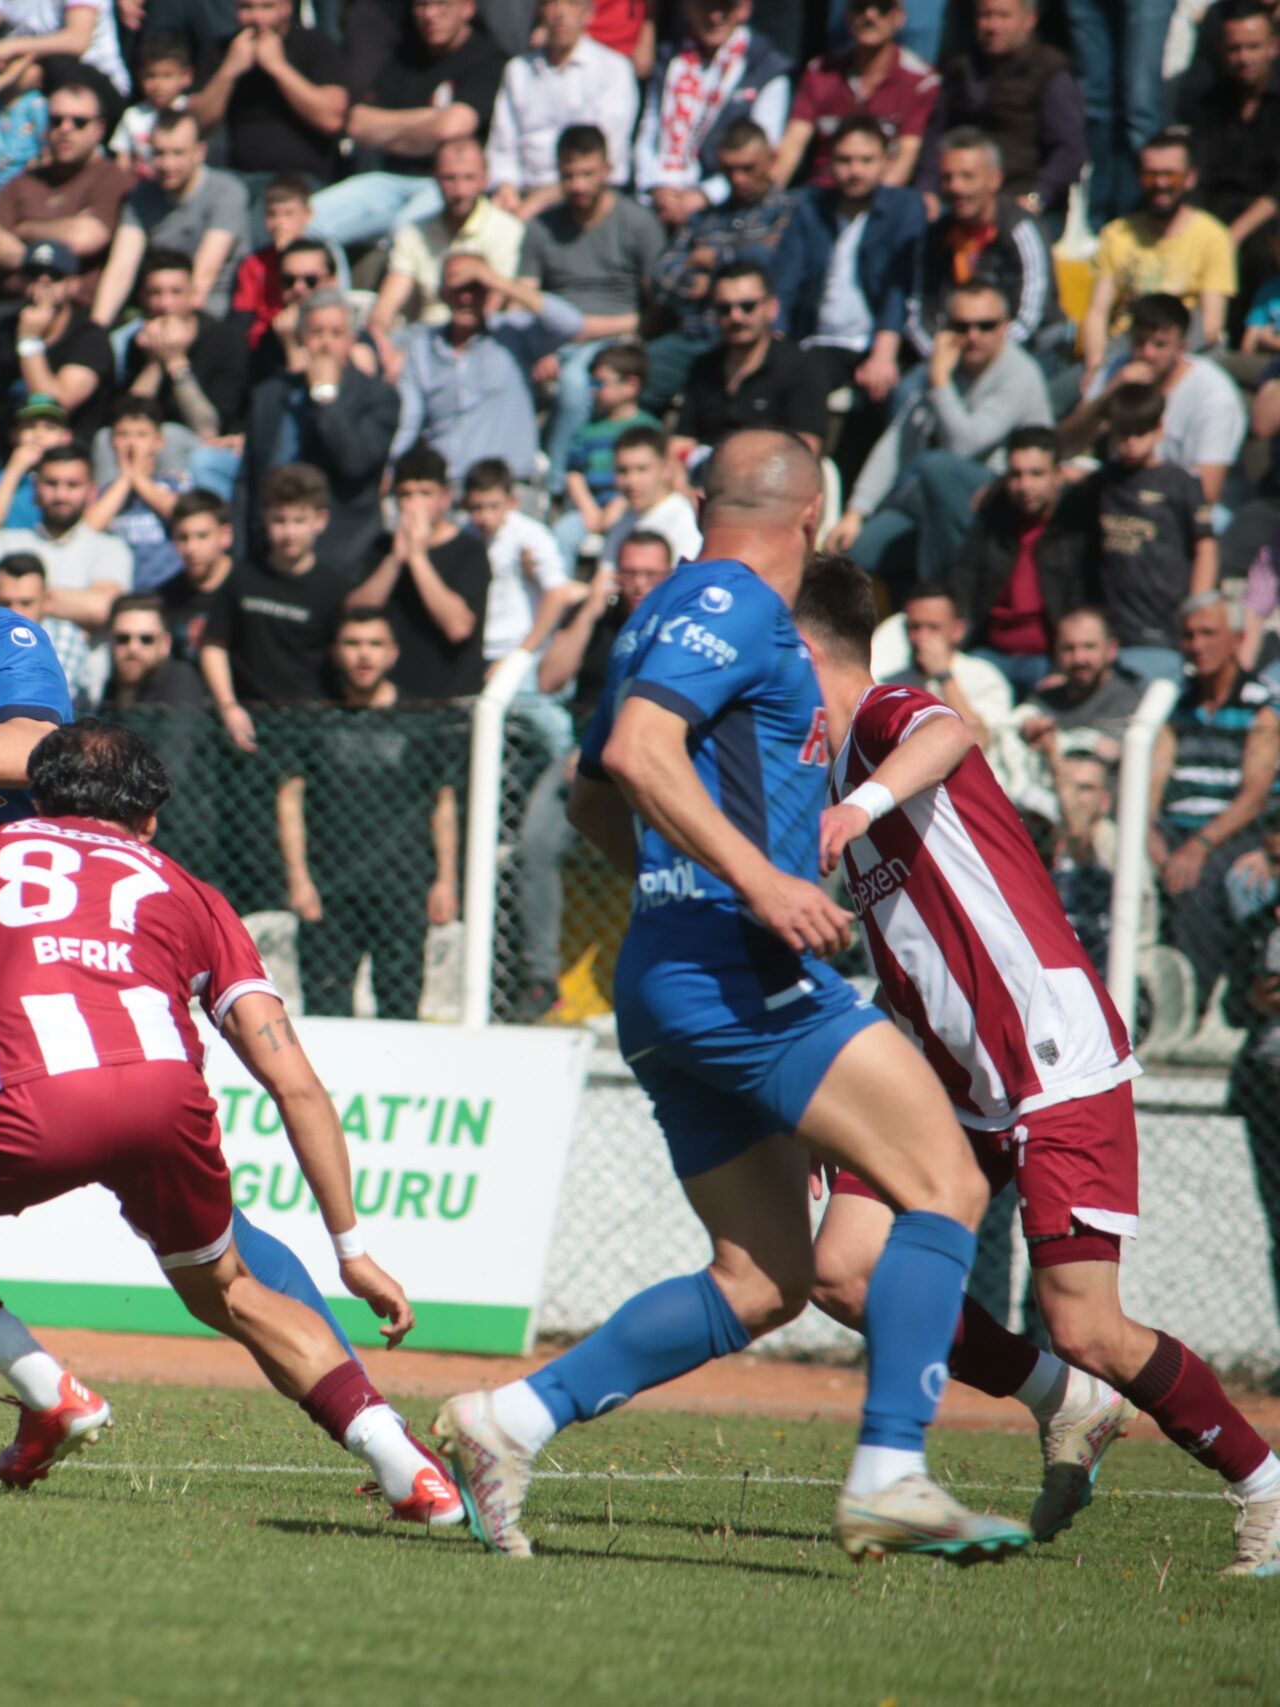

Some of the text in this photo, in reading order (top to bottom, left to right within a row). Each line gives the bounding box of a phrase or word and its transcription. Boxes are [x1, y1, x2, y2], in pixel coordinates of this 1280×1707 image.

[31, 935, 135, 974] BERK
[220, 1086, 494, 1147] TOAT'IN
[230, 1161, 479, 1220] GUURU
